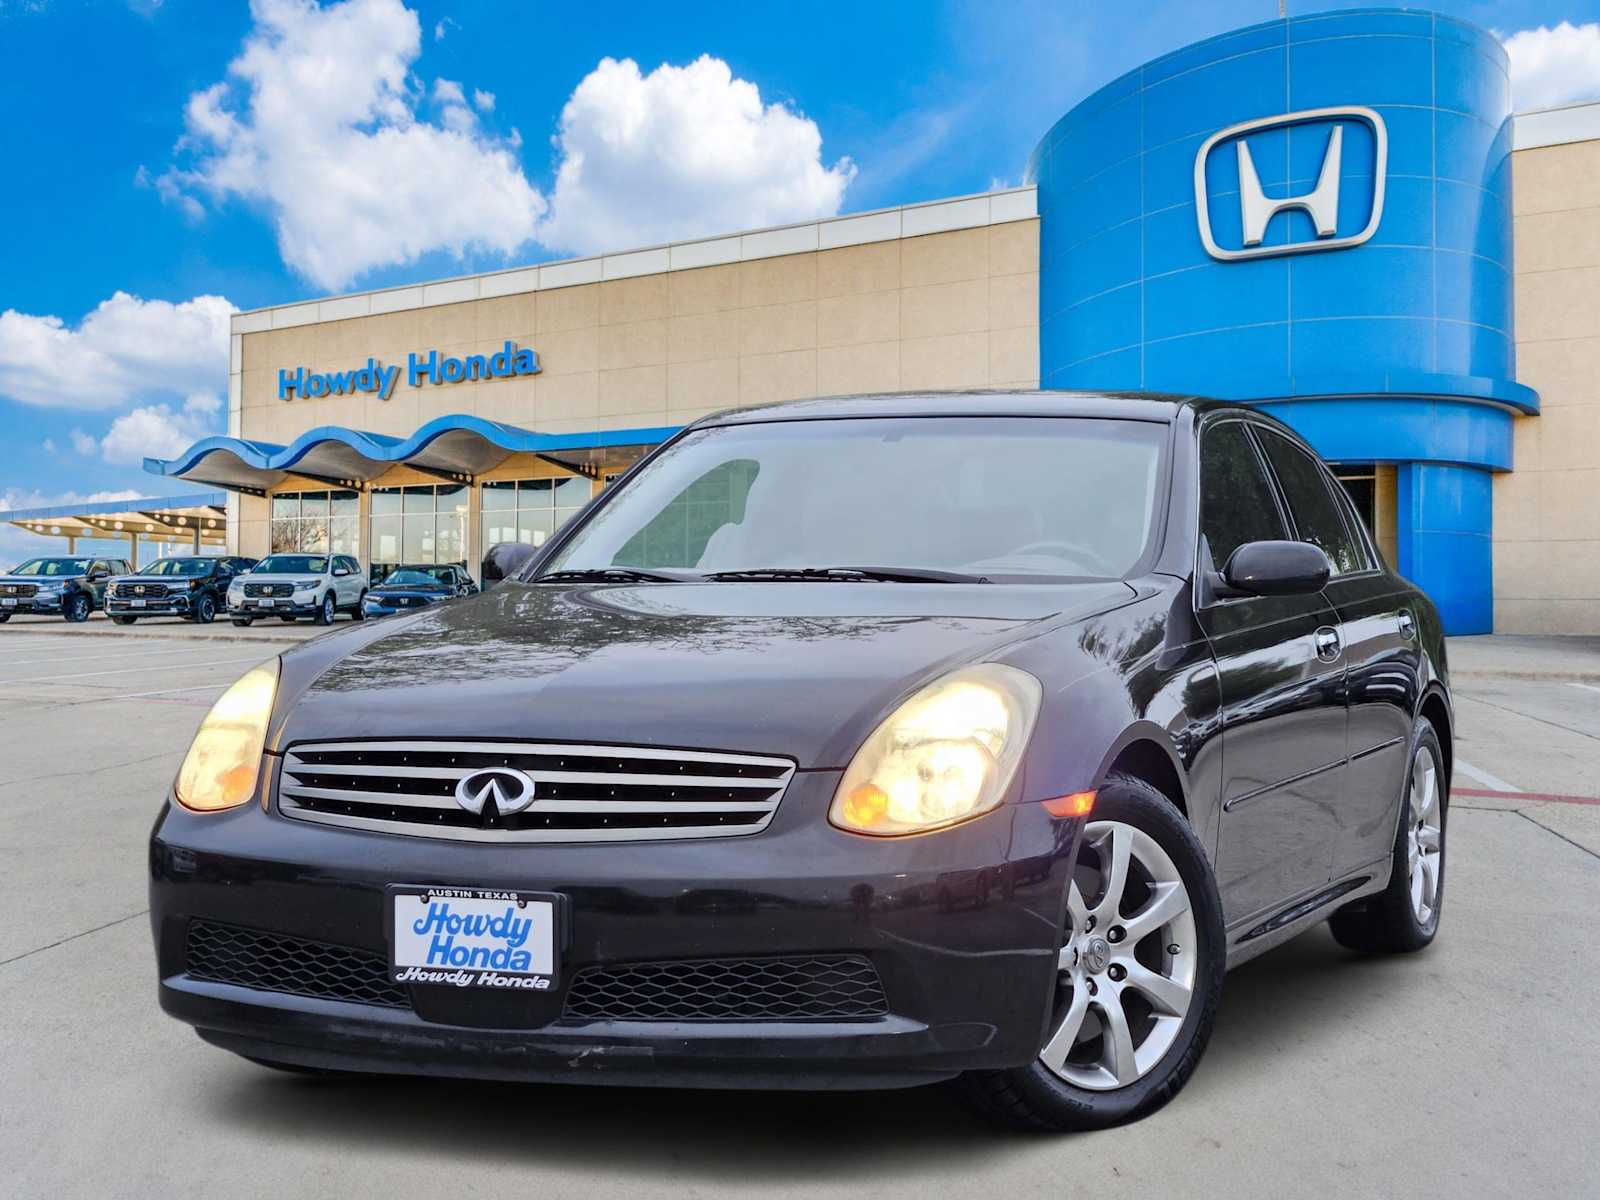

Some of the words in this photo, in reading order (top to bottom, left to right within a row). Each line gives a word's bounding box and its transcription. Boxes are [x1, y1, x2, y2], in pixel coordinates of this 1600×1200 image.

[278, 358, 401, 401] Howdy
[408, 340, 542, 388] Honda
[427, 889, 473, 899] AUSTIN
[477, 891, 518, 901] TEXAS
[413, 903, 532, 948] Howdy
[426, 935, 532, 971] Honda
[395, 967, 475, 987] Howdy
[477, 971, 550, 989] Honda
